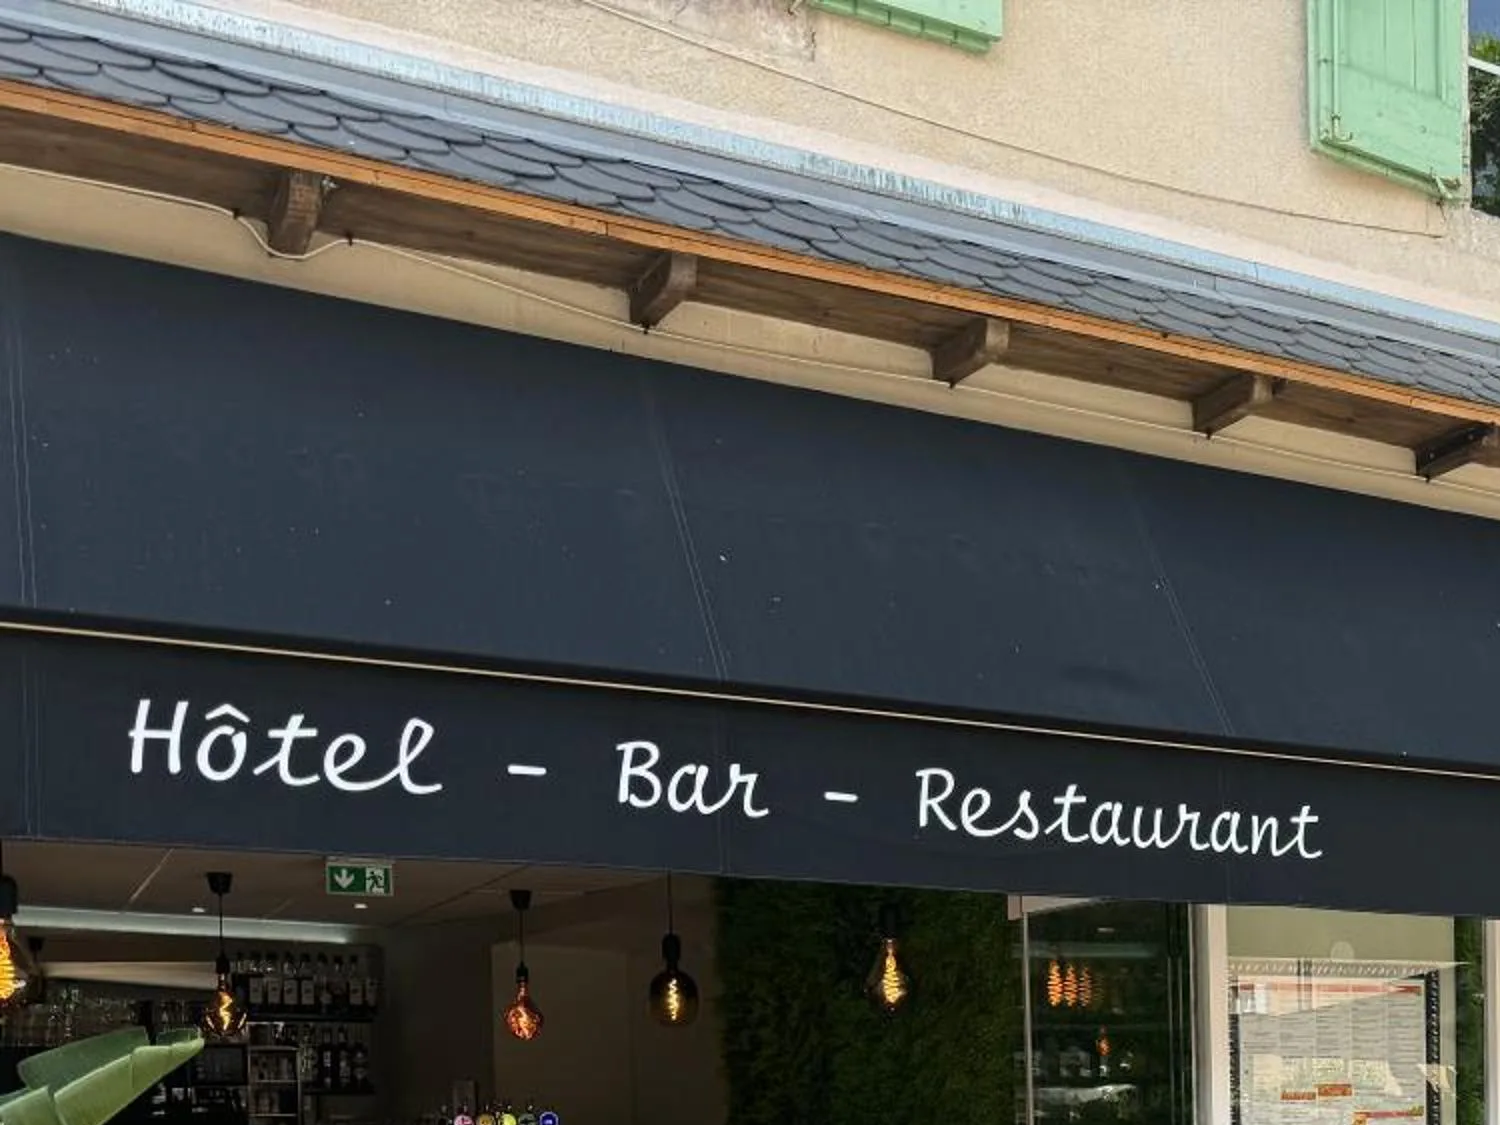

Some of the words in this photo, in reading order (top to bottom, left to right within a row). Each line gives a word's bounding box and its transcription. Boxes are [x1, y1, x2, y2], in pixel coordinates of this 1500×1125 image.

[128, 698, 443, 795] Hôtel
[615, 740, 769, 818] Bar
[915, 767, 1323, 860] Restaurant
